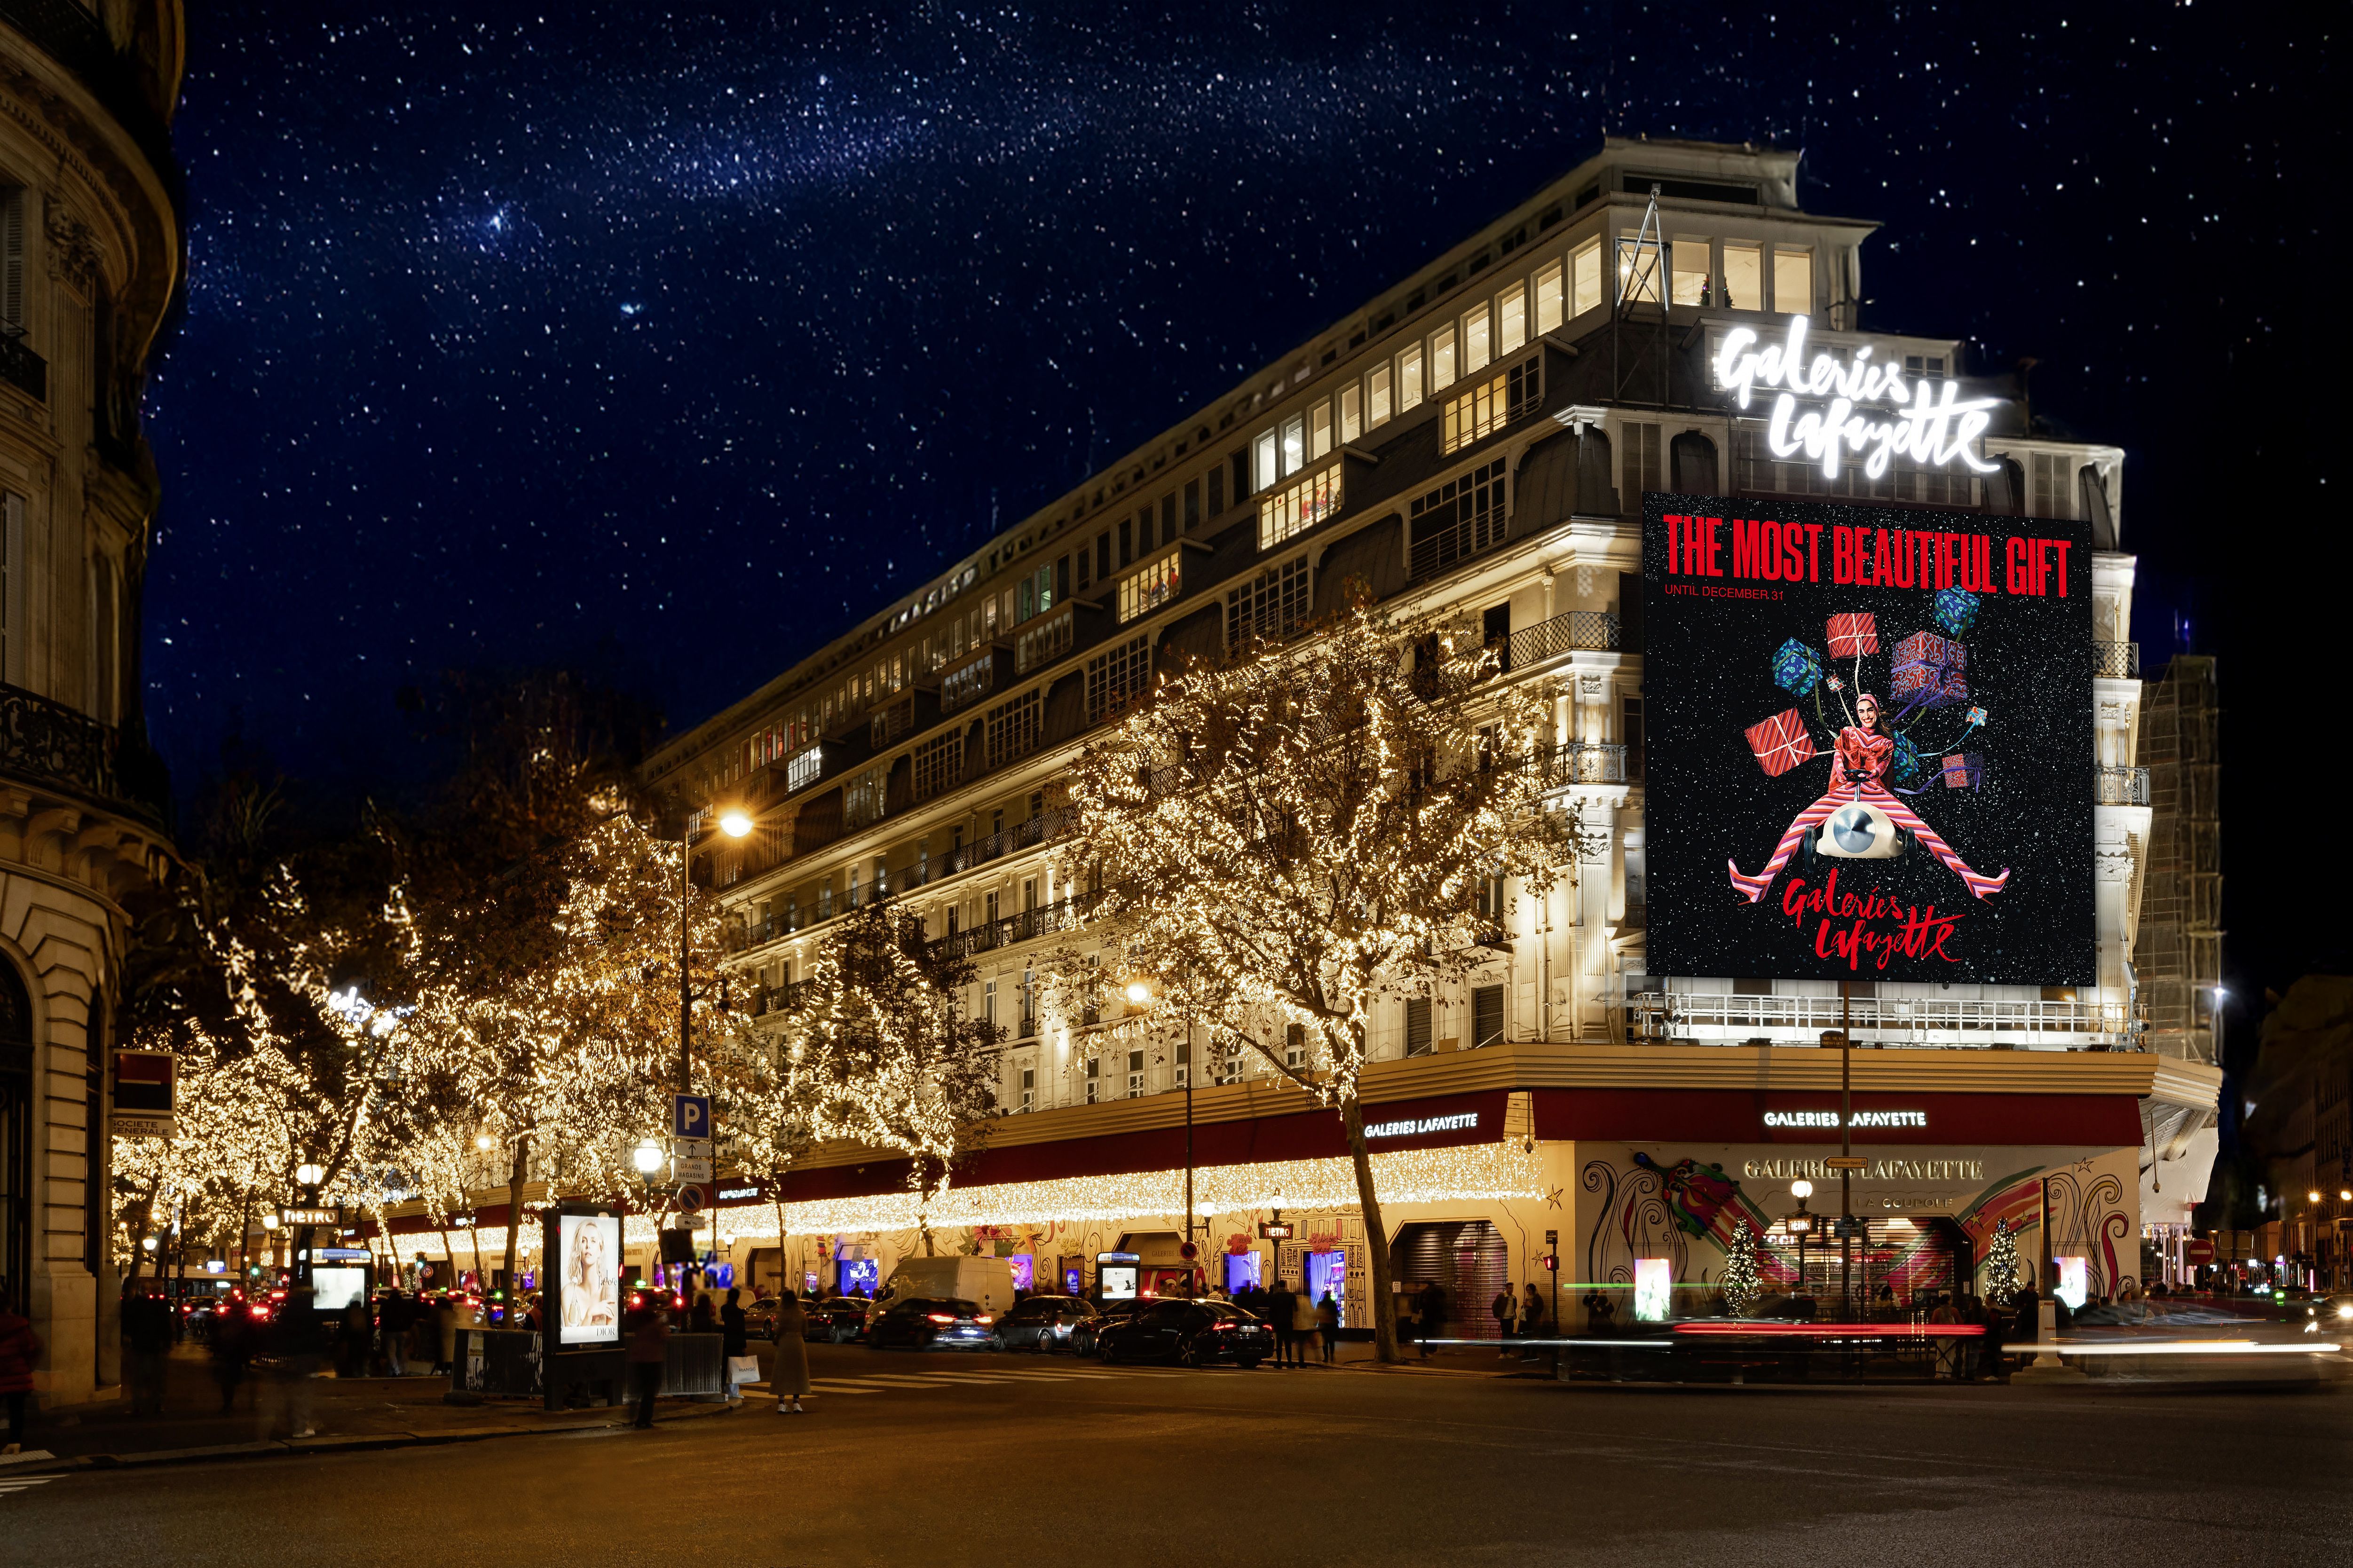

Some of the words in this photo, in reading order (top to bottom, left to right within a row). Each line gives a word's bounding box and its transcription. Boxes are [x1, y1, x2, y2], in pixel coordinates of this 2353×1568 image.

[1716, 315, 1910, 409] Galeries
[1769, 380, 2000, 479] Lafayette
[1663, 515, 1723, 577] THE
[1733, 519, 1823, 583] MOST
[1833, 525, 1997, 593] BEAUTIFUL
[2006, 536, 2071, 597] GIFT
[1665, 584, 1697, 596] UNTIL
[1702, 586, 1768, 600] DECEMBER
[1772, 591, 1784, 600] 31
[1783, 868, 1903, 929] Galeries
[1815, 906, 1966, 970] Lafayette
[685, 1103, 700, 1130] P
[1365, 1120, 1416, 1138] GALERIES
[1417, 1113, 1478, 1133] LAFAYETTE
[1764, 1112, 1840, 1127] GALERIES
[1848, 1112, 1926, 1127] AFAYETTE
[1862, 1159, 1984, 1179] LAFAYETTE
[1856, 1198, 1876, 1207] LA
[1882, 1198, 1952, 1208] COUPOLE
[284, 1209, 336, 1223] METRO
[1788, 1220, 1810, 1231] METRO
[1265, 1227, 1290, 1237] METRO
[597, 1327, 615, 1336] DIOR
